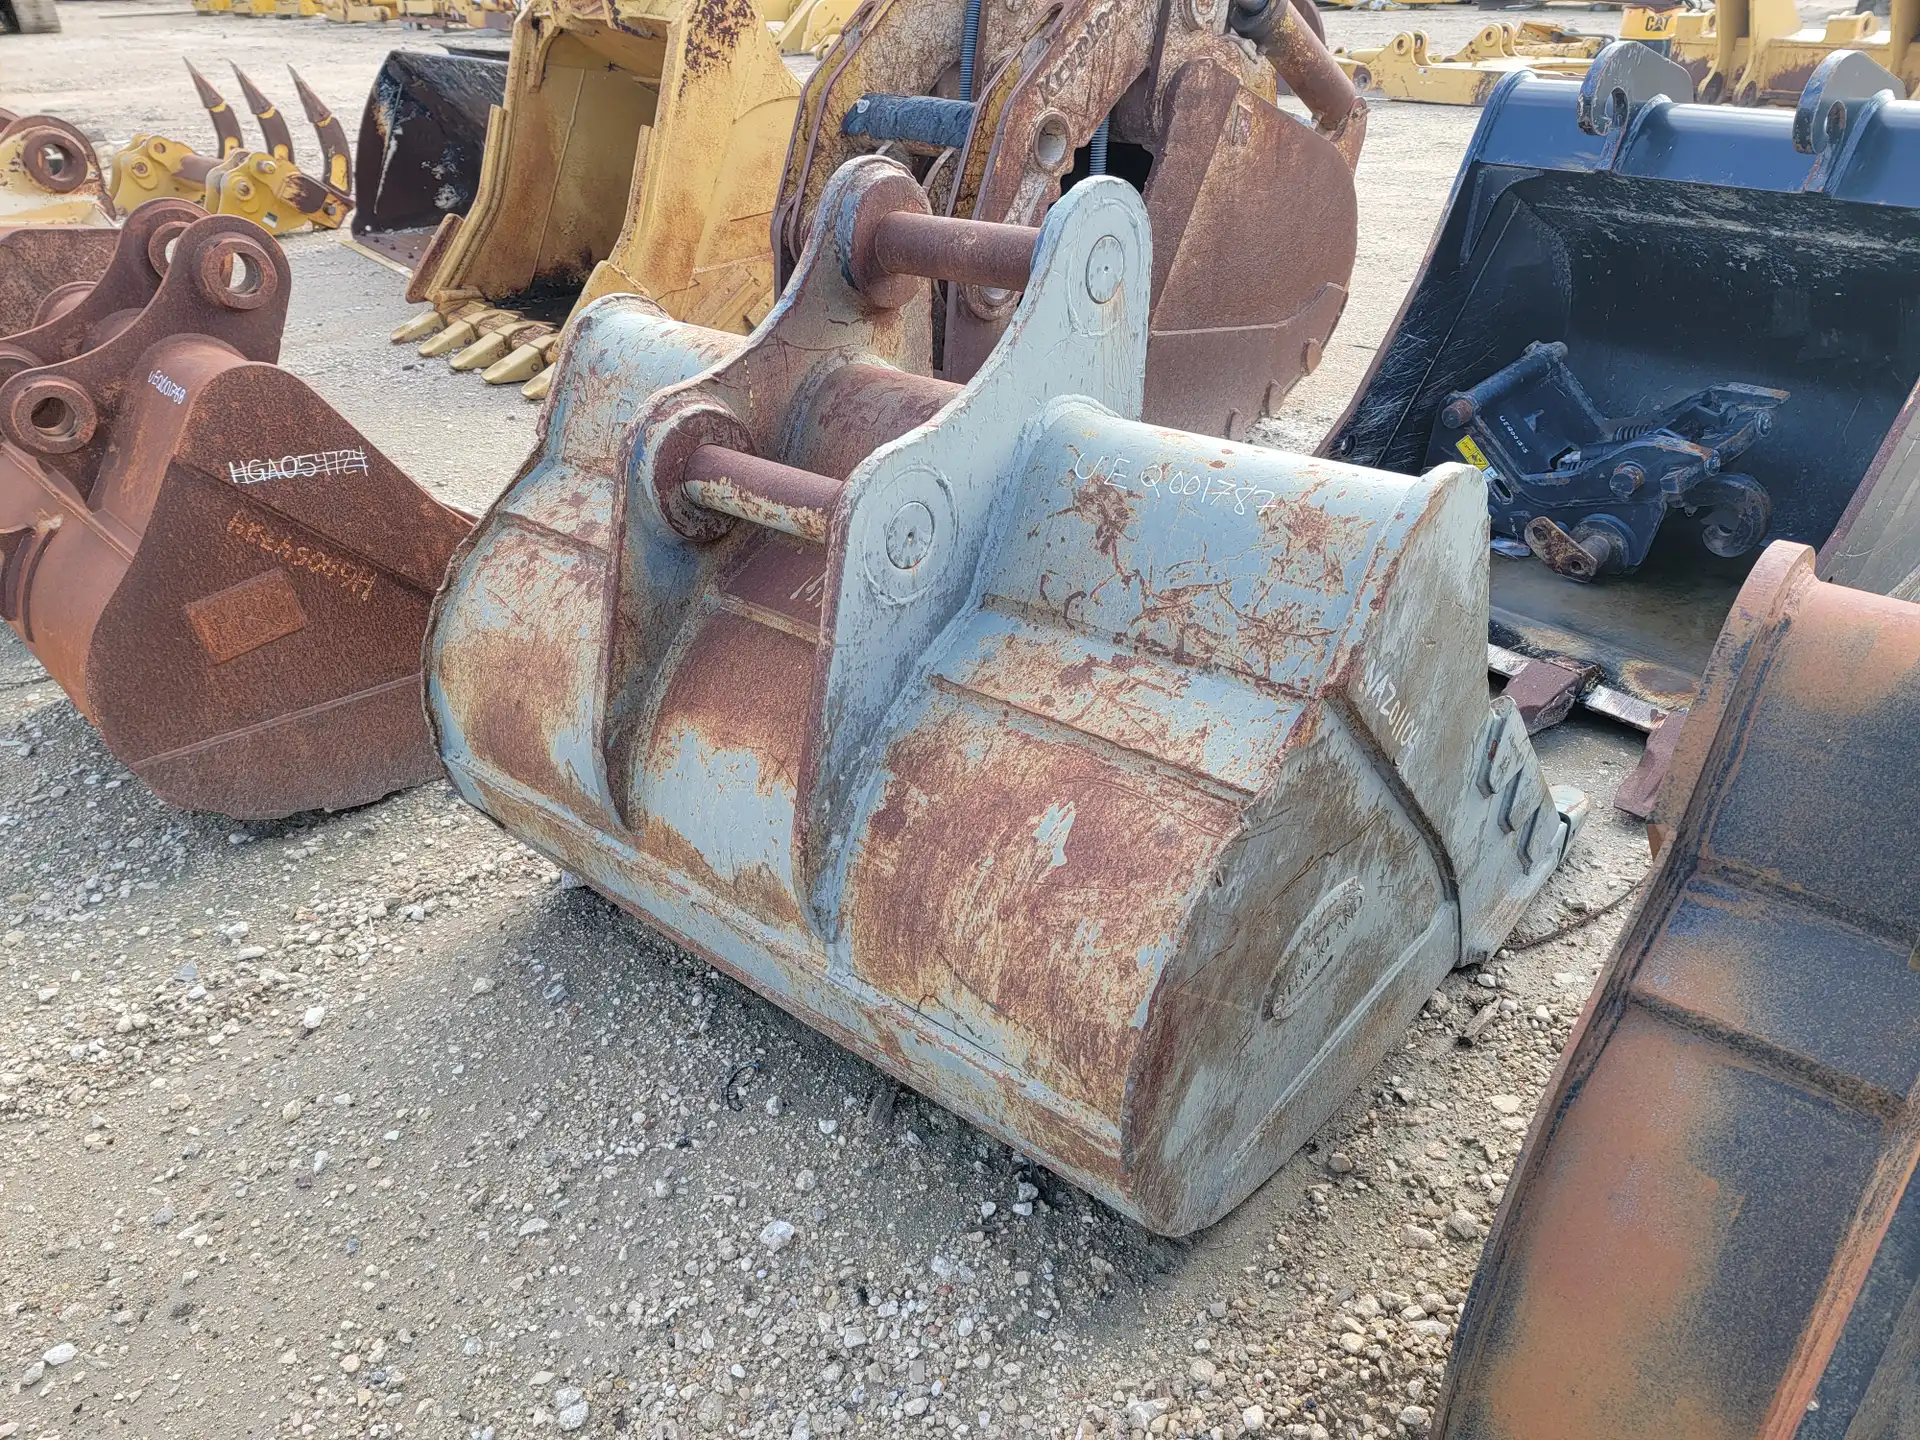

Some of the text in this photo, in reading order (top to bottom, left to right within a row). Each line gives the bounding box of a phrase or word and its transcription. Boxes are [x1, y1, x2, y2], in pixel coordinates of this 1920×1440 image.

[1645, 14, 1672, 31] CAT
[228, 446, 369, 484] HGA054724
[1074, 452, 1277, 515] UEQ001787
